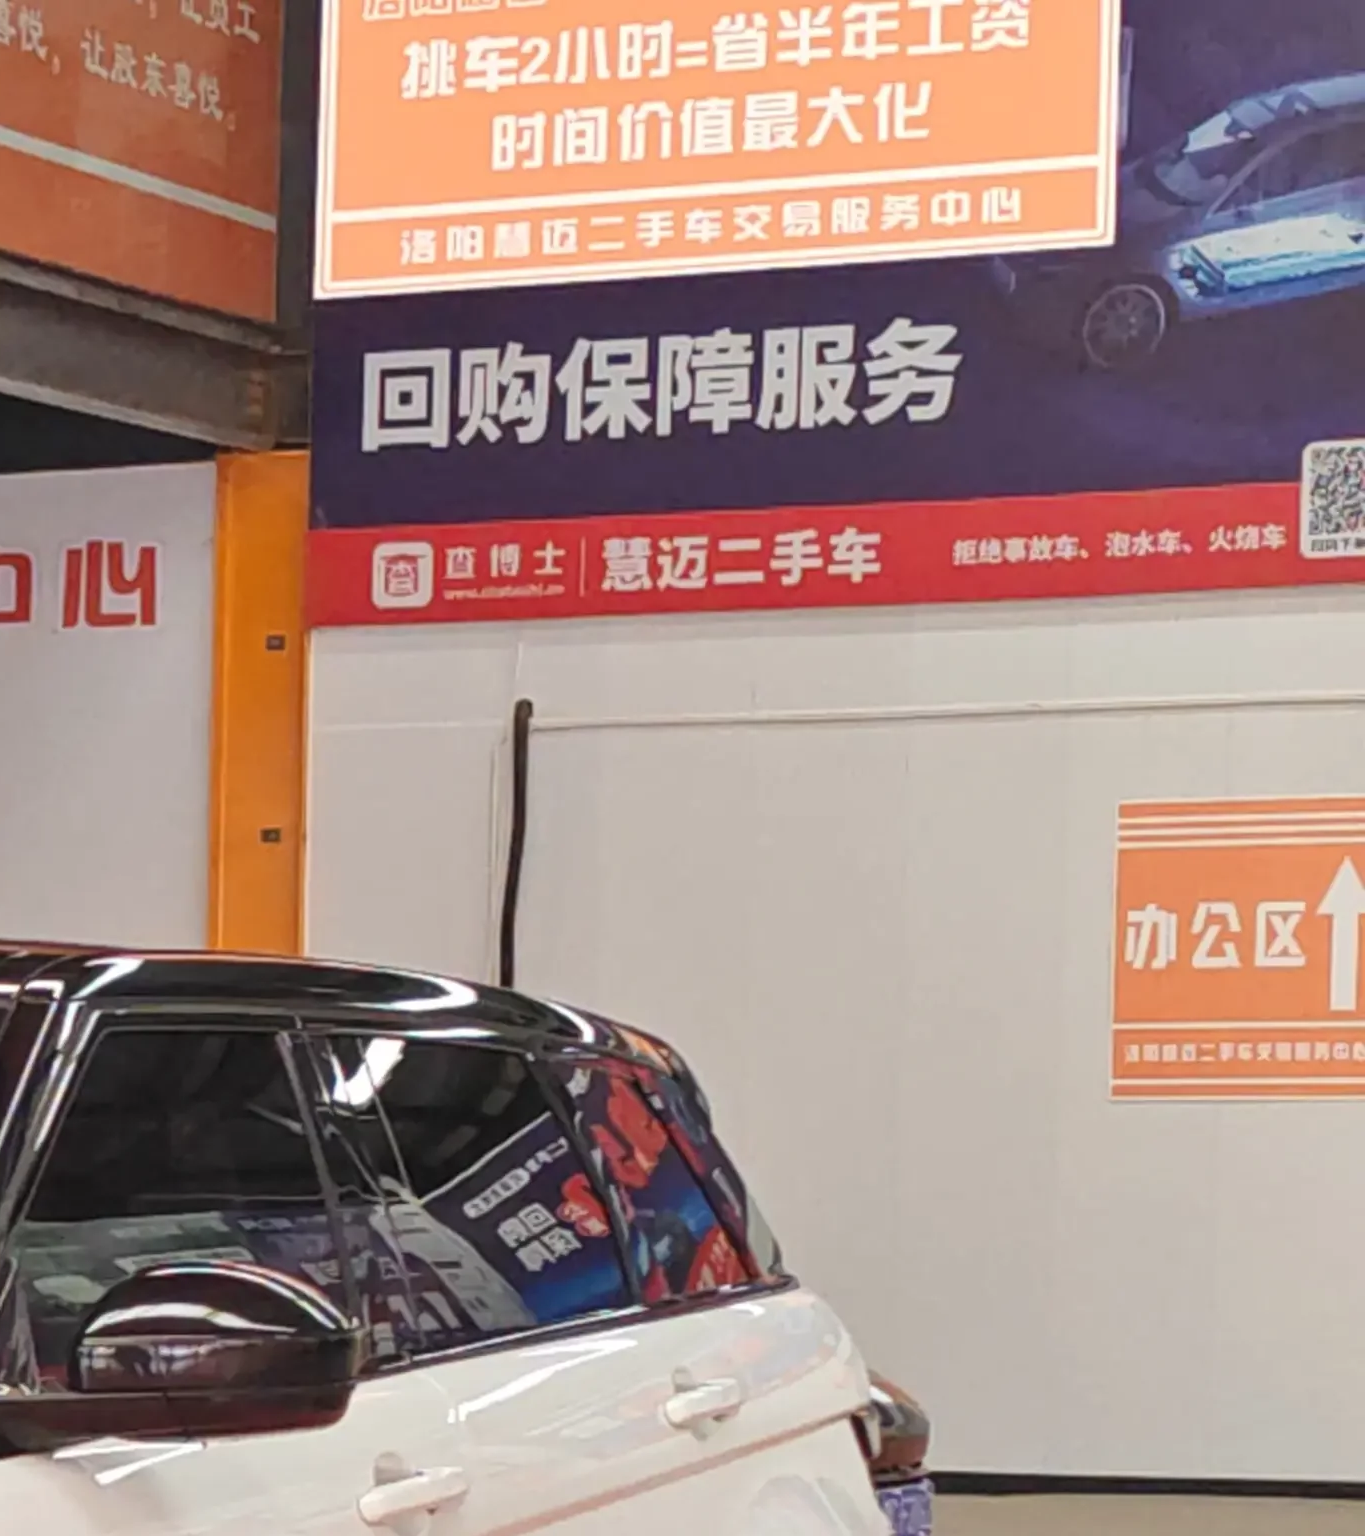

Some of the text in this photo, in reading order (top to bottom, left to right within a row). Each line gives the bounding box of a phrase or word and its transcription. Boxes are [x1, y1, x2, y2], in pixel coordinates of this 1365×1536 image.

[400, 0, 1029, 99] 挑车2小时=省半年工资
[490, 81, 932, 172] 时间价值最大化
[399, 188, 1024, 266] 洛阳慧迈二手车交易服务中心
[360, 317, 962, 453] 回购保障服务
[600, 527, 883, 594] 慧迈二手车
[1124, 901, 1307, 970] 办公区
